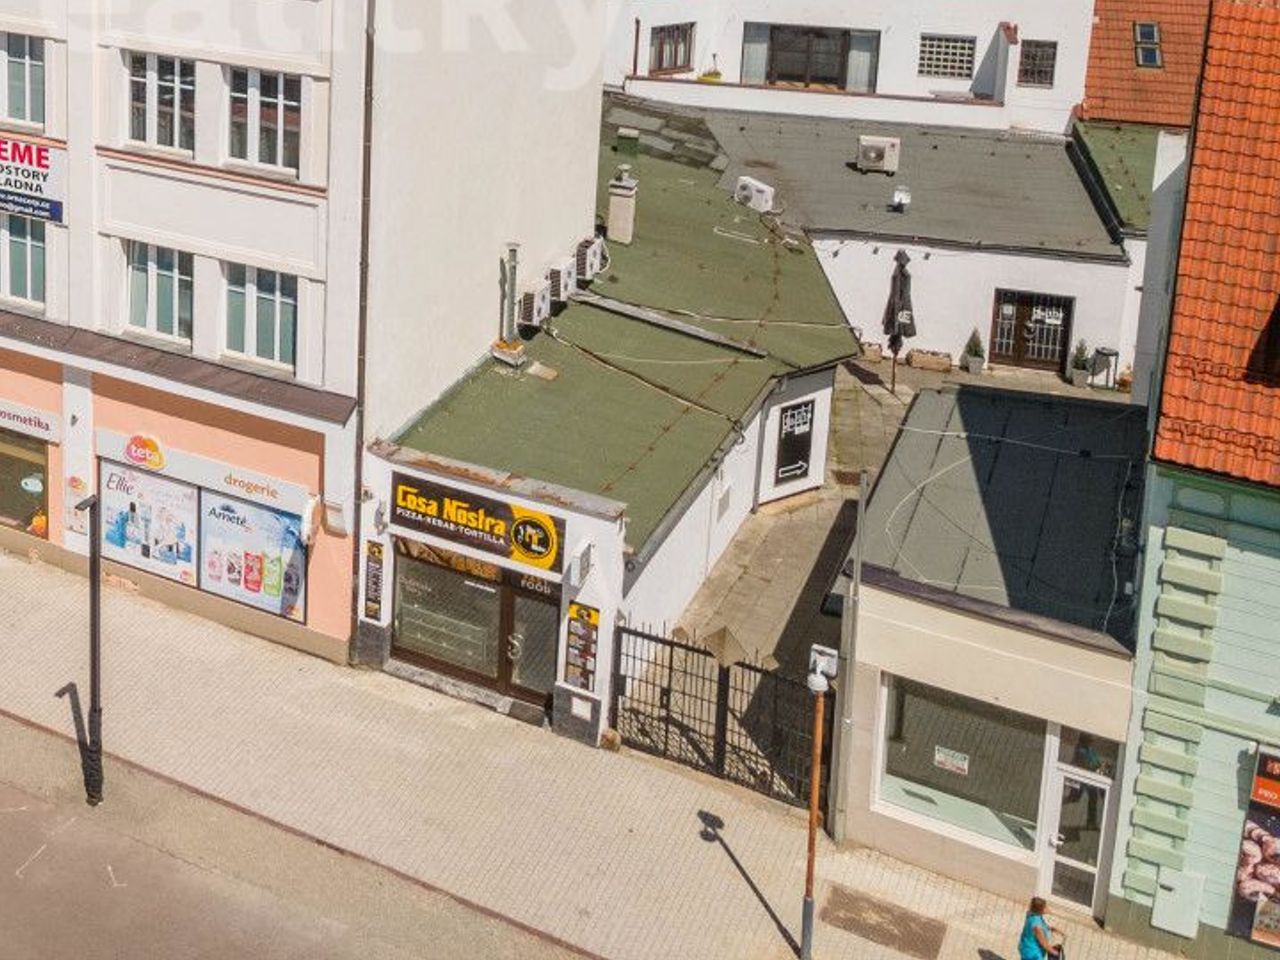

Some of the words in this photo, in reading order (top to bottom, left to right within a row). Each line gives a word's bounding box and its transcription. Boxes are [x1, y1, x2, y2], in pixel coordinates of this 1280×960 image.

[106, 472, 135, 495] Ellie
[223, 473, 279, 500] drogerie
[396, 484, 438, 514] Cosa
[442, 497, 507, 537] Nostra
